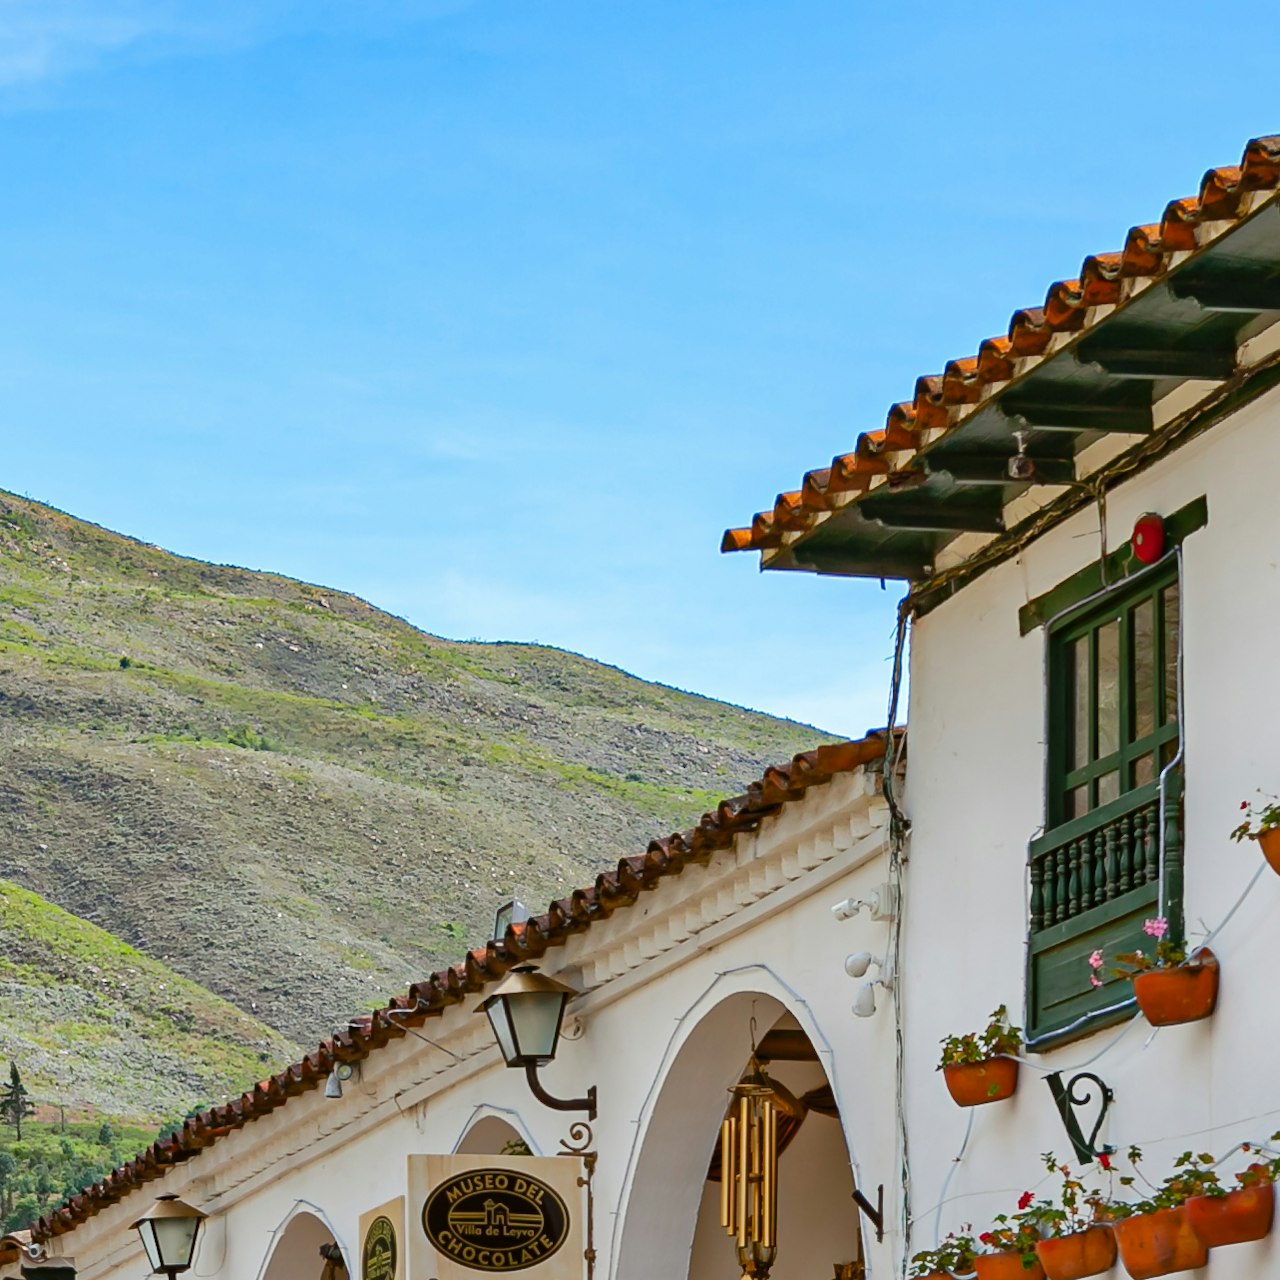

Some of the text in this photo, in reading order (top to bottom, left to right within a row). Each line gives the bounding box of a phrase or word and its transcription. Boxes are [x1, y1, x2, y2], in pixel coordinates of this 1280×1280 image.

[445, 1174, 545, 1205] MUSEO DEL
[456, 1224, 535, 1239] Villa de Leyva
[438, 1230, 554, 1267] CHOCOLATE
